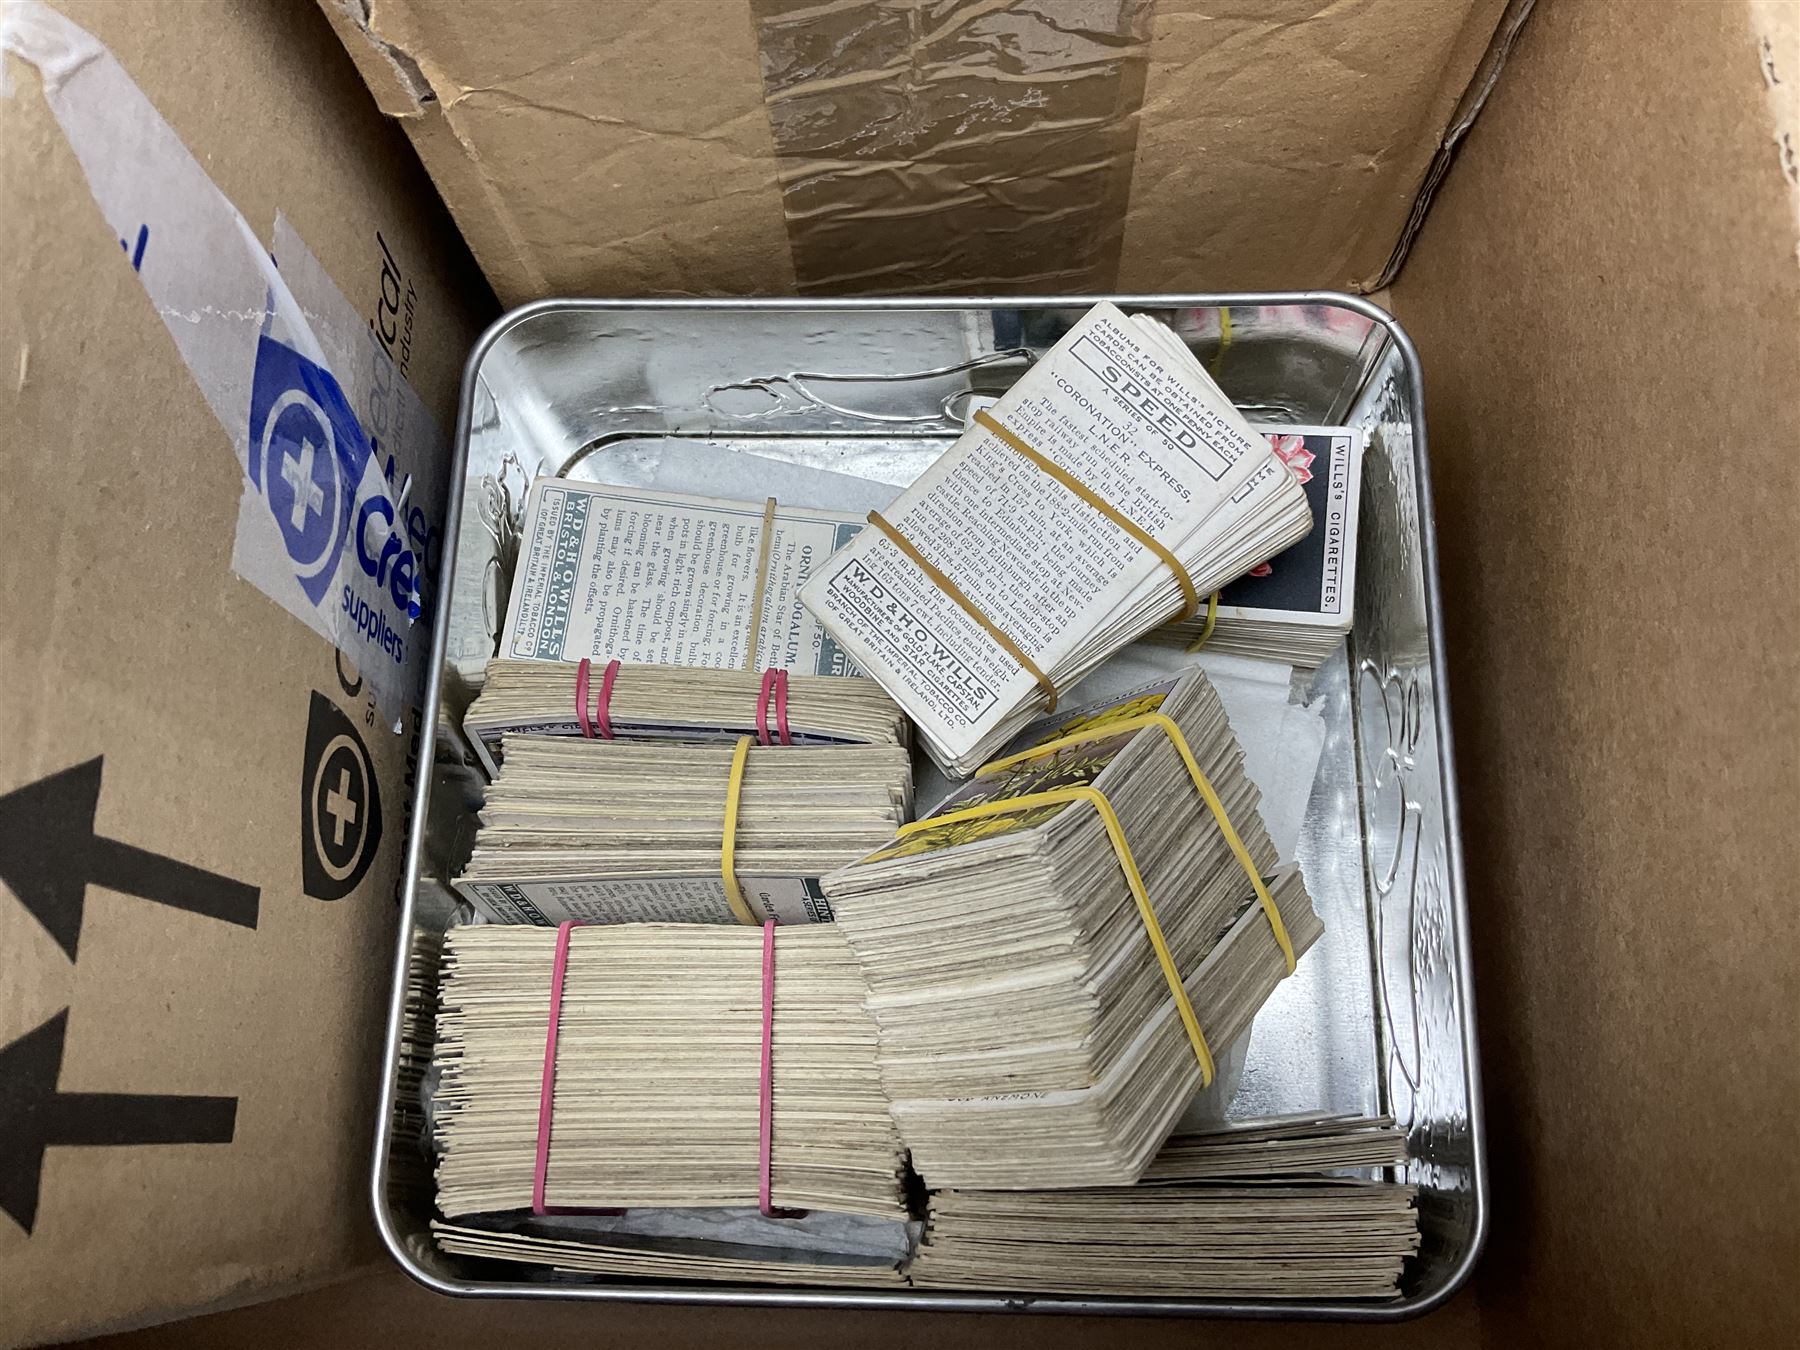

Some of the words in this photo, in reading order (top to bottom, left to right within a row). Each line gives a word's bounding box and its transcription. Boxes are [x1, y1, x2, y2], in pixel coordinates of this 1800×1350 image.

[1088, 329, 1151, 386] TOBACCONISTS
[1150, 386, 1163, 396] AT
[1163, 397, 1183, 414] ONE
[1181, 413, 1212, 439] PENNY
[1212, 439, 1237, 462] EACH
[1094, 323, 1125, 351] CARDS
[1127, 352, 1146, 371] CAN
[1149, 372, 1162, 385] BE
[1164, 386, 1212, 428] OBTAINED
[1214, 430, 1244, 456] FROM
[1100, 317, 1140, 352] ALBUMS
[1142, 354, 1163, 373] FOR
[1206, 410, 1251, 450] PICTURE
[1101, 365, 1196, 448] SPEED
[1101, 387, 1109, 395] A
[1112, 395, 1142, 422] SERIES
[1145, 424, 1158, 435] OF
[1161, 438, 1174, 450] 50
[1039, 396, 1057, 415] The
[1058, 414, 1088, 443] fastest
[1089, 444, 1135, 485] scheduled
[1122, 421, 1138, 436] 32
[1137, 450, 1193, 503] EXPRESS,
[548, 497, 561, 526] ISSUED
[600, 507, 612, 520] by
[613, 508, 626, 532] lums
[535, 521, 546, 545] GREAT
[545, 529, 554, 540] BY
[555, 500, 575, 568] BRISTOL
[623, 510, 639, 545] forcing
[634, 512, 653, 556] blooming
[654, 513, 663, 536] near
[666, 516, 677, 541] when
[680, 517, 690, 538] pots
[692, 519, 705, 550] should
[734, 524, 745, 546] bulb
[747, 526, 759, 544] like
[541, 544, 551, 560] THE
[592, 522, 608, 562] planting
[607, 535, 619, 558] may
[623, 547, 632, 556] if
[650, 540, 660, 557] the
[679, 539, 688, 549] in
[702, 520, 717, 575] greenhouse
[715, 522, 730, 577] greenhouse
[785, 541, 796, 561] The
[529, 545, 541, 576] BRITAIN
[605, 560, 616, 580] also
[632, 560, 641, 578] can
[657, 547, 671, 587] growing
[674, 552, 687, 576] light
[690, 552, 700, 565] be
[730, 553, 741, 567] for
[741, 545, 755, 582] flowers.
[1324, 512, 1341, 607] CIGARETTES.
[534, 562, 547, 599] IMPERIAL
[591, 563, 601, 579] the
[615, 559, 630, 597] desired.
[644, 561, 657, 589] glass.
[684, 566, 695, 597] grown
[778, 563, 792, 602] Arabian
[602, 583, 613, 596] be
[630, 582, 640, 594] be
[671, 578, 681, 597] rich
[713, 578, 720, 589] or
[720, 574, 735, 614] growing
[639, 597, 651, 618] The
[692, 581, 709, 632] decoration
[710, 591, 720, 606] for
[736, 604, 746, 613] is
[738, 592, 747, 602] It
[784, 544, 812, 668] ORNIOGALUM.
[341, 583, 403, 664] suppliers
[527, 601, 540, 638] TOBACCO
[538, 584, 559, 654] LONDON.
[621, 598, 637, 642] hastened
[661, 600, 676, 644] compost,
[677, 598, 692, 628] singly
[719, 620, 730, 630] in
[733, 614, 741, 626] an
[775, 604, 786, 625] Star
[842, 574, 894, 624] MANUFACTURERS
[893, 624, 903, 632] OF
[902, 632, 923, 652] GOLD
[591, 600, 607, 656] propagated
[635, 623, 646, 645] time
[649, 631, 660, 643] be
[677, 628, 687, 638] in
[702, 608, 718, 647] forcing.
[772, 628, 782, 639] of
[727, 629, 739, 669] excellen
[811, 632, 821, 650] 50.
[826, 588, 857, 618] BRANCH
[856, 617, 868, 628] OF
[868, 629, 884, 645] THE
[883, 644, 918, 680] IMPERIAL
[920, 678, 954, 713] TOBACCO
[842, 584, 884, 627] WOODBINE
[884, 628, 900, 643] AND
[901, 643, 925, 666] STAR
[926, 669, 969, 711] CIGARETTES
[885, 602, 899, 616] &
[931, 642, 987, 699] WILLS
[617, 647, 629, 660] by
[632, 650, 641, 662] of
[645, 648, 654, 663] set
[659, 645, 669, 665] and
[711, 651, 724, 669] coo
[838, 612, 864, 636] GREAT
[863, 636, 894, 667] BRITAIN
[937, 709, 955, 729] LTD.
